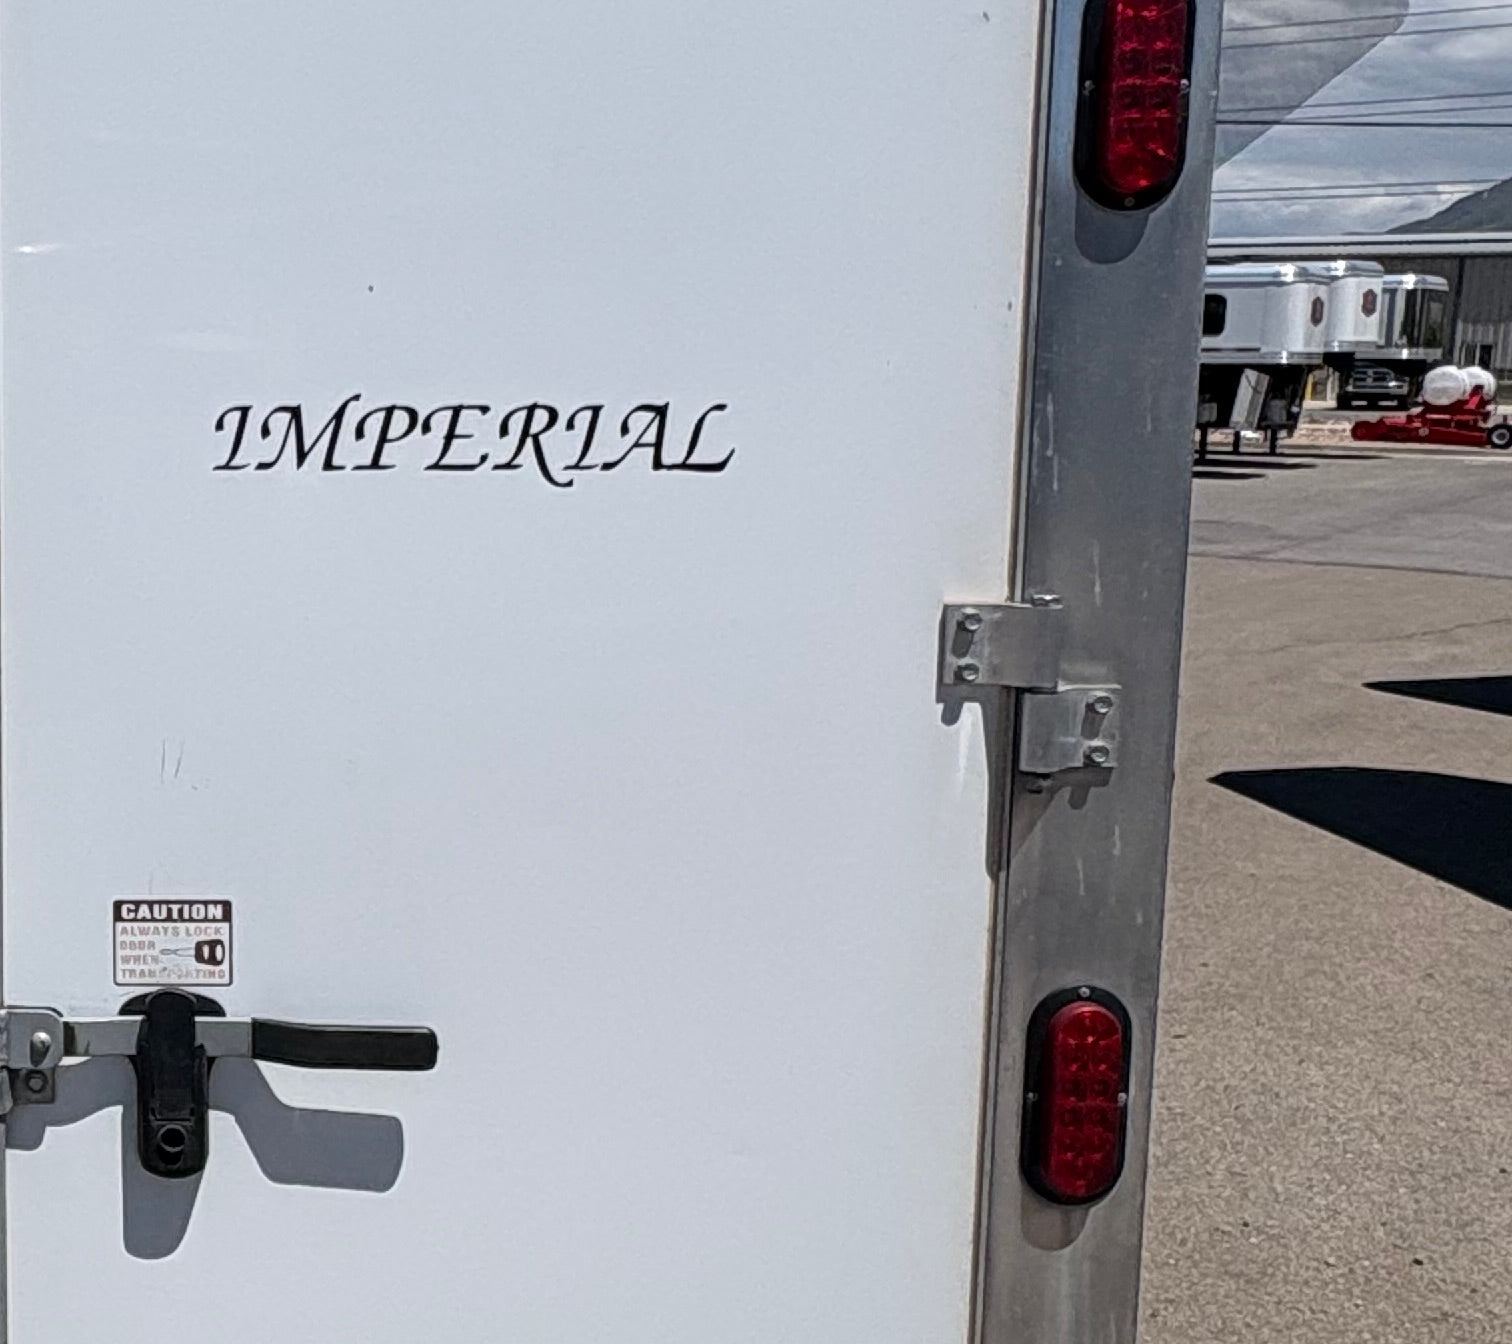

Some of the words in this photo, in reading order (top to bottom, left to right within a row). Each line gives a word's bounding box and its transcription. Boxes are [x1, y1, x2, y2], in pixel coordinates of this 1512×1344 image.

[212, 393, 736, 488] IMPERIAL
[120, 904, 224, 920] CAUTION
[120, 926, 180, 937] ALWAYS
[185, 926, 224, 937] LOCK
[120, 940, 156, 951] DOOR
